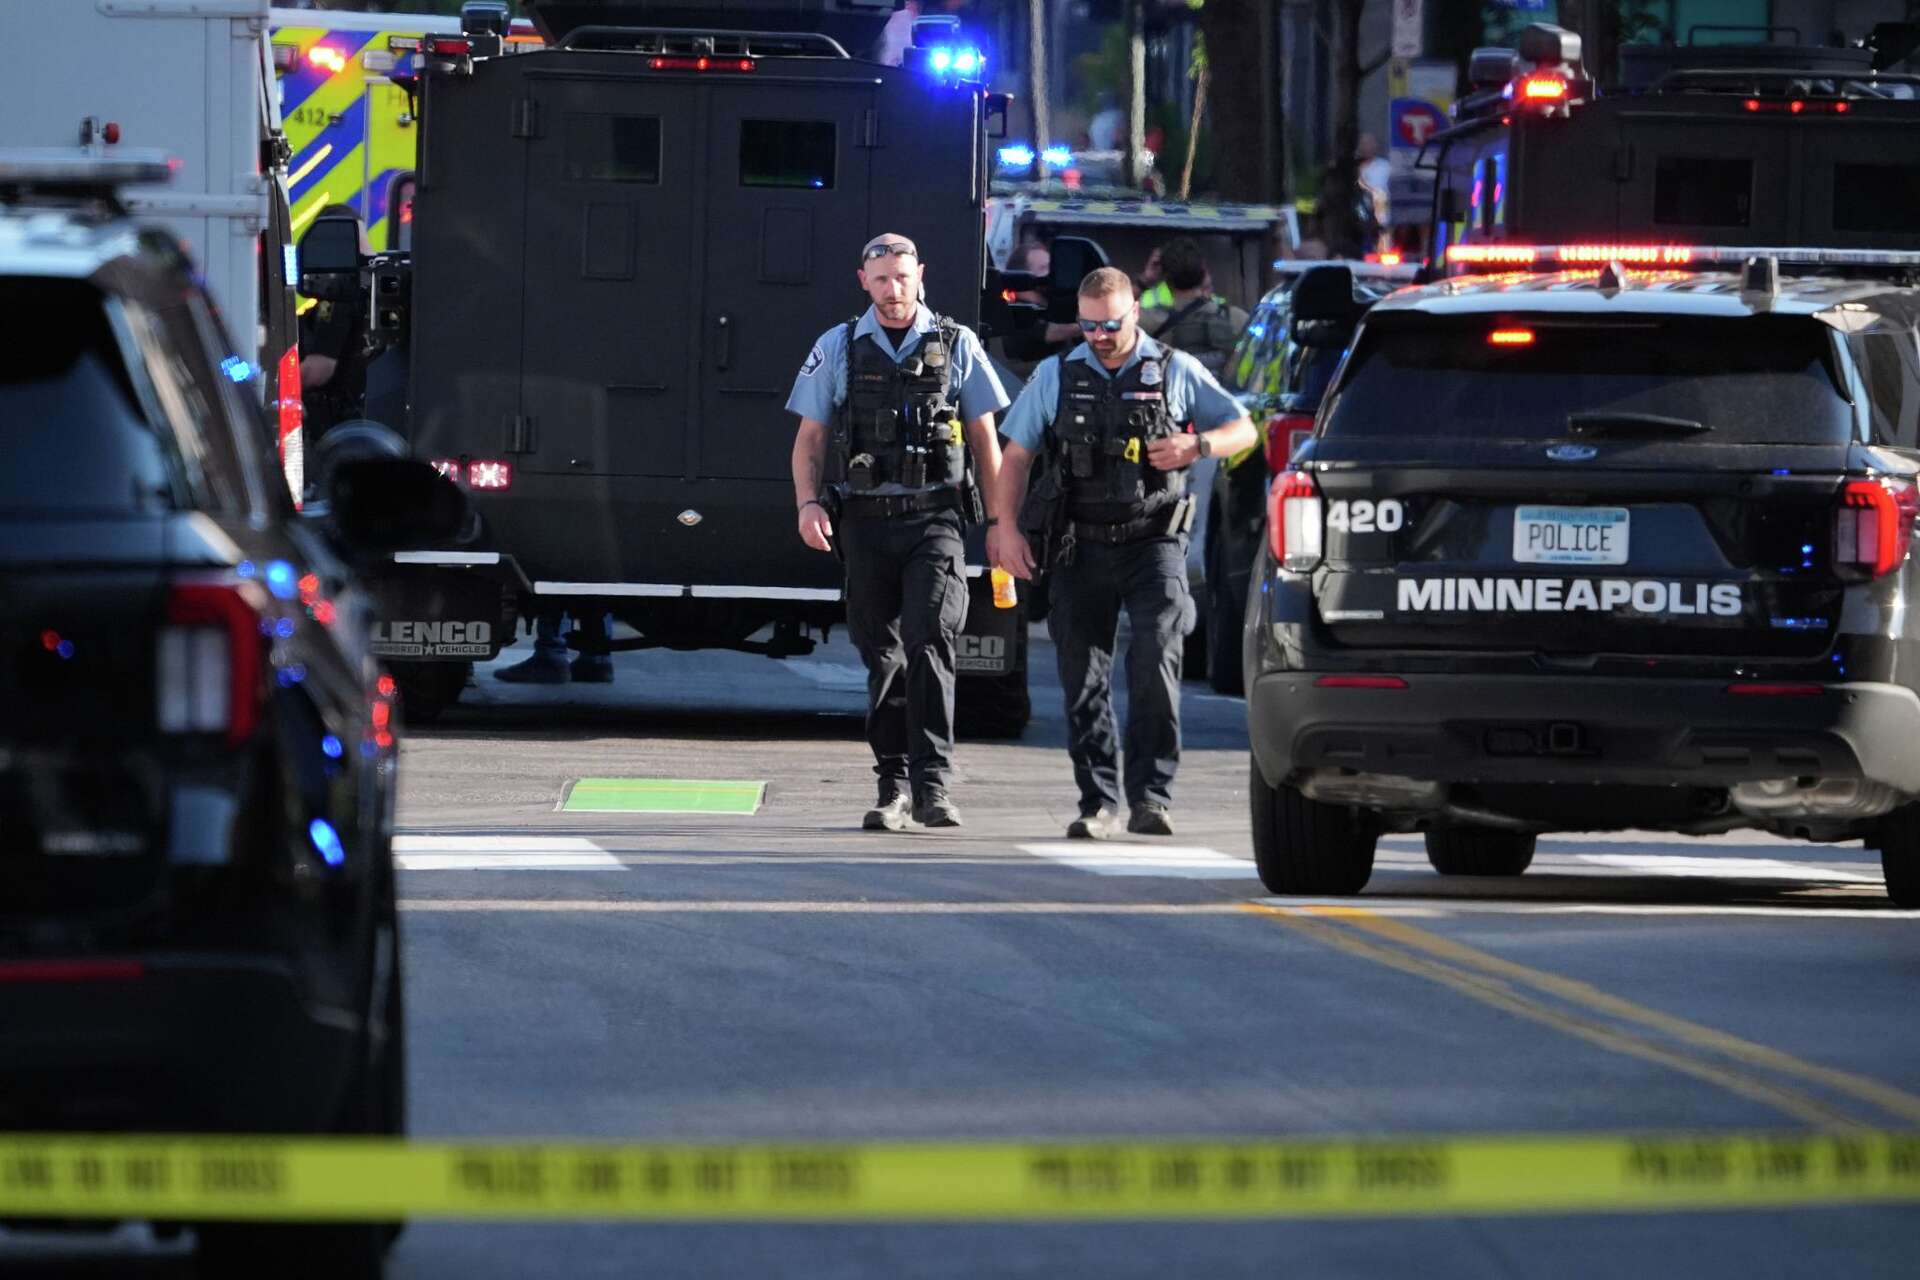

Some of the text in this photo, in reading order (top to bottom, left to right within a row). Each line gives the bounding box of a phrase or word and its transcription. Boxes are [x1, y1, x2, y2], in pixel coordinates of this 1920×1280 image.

[294, 107, 325, 127] 412
[1327, 498, 1404, 533] 420
[1528, 523, 1612, 552] POLICE
[1397, 578, 1743, 616] MINNEAPOLIS
[370, 621, 491, 643] LENCO
